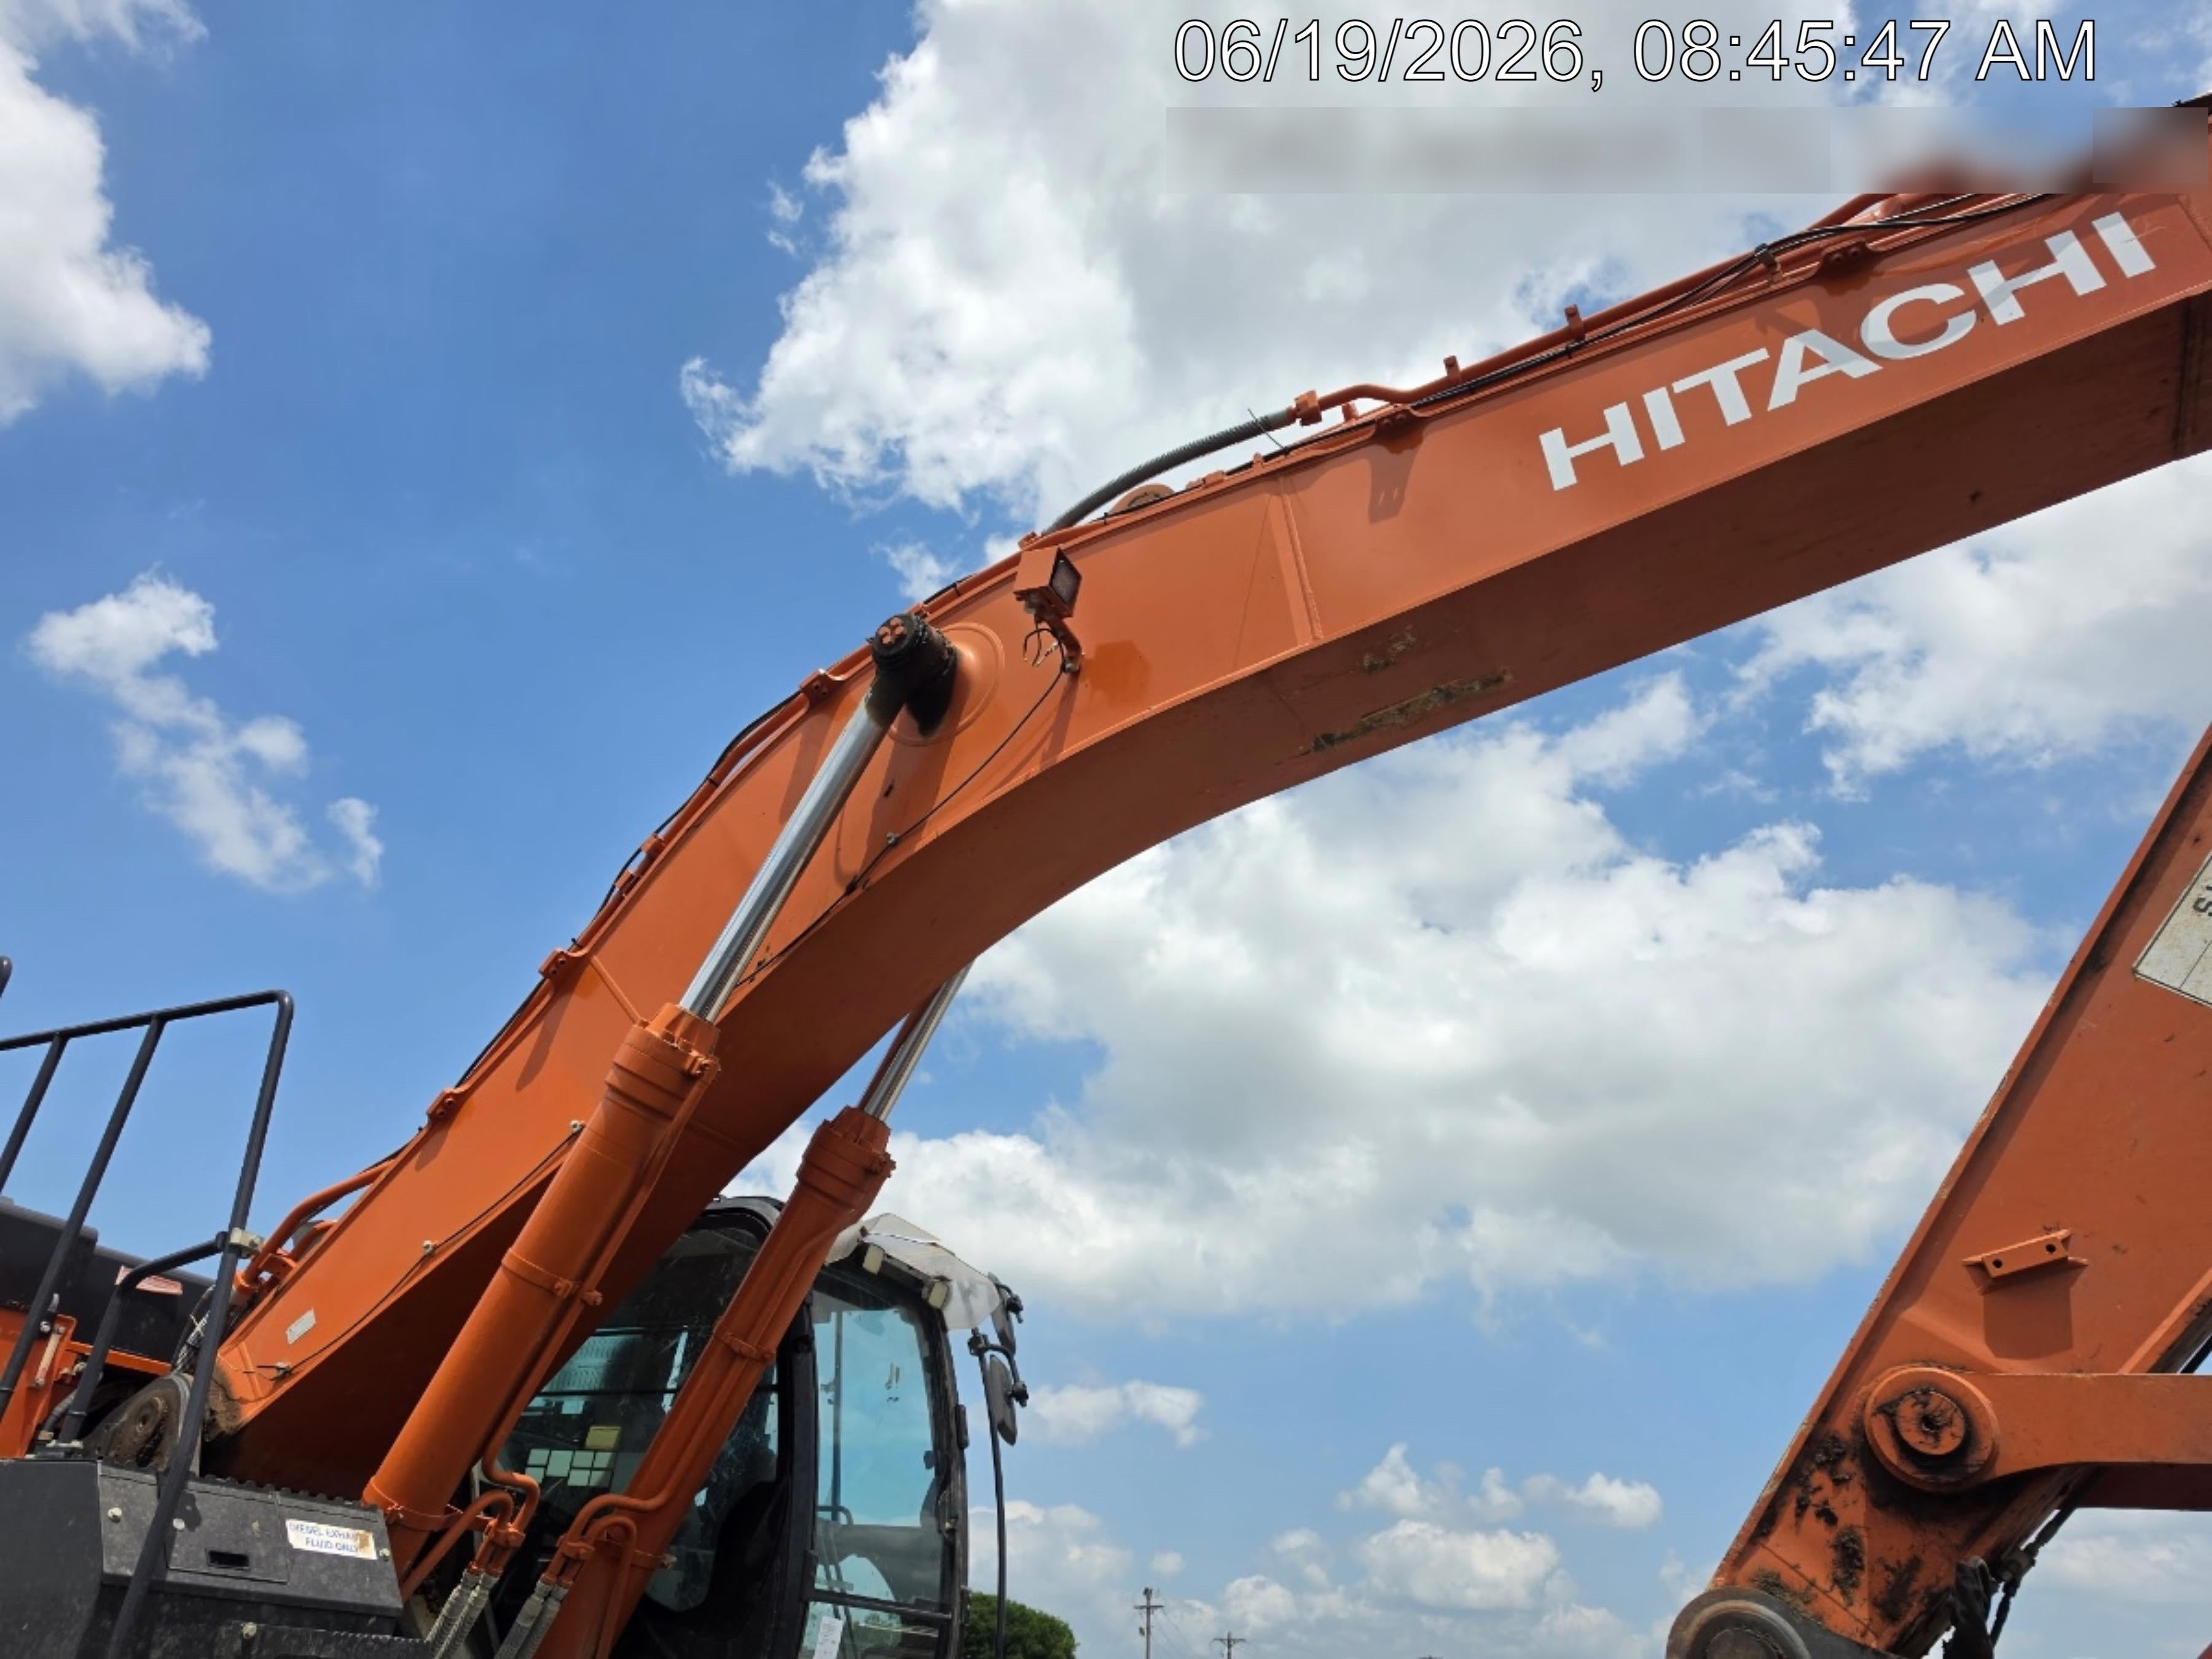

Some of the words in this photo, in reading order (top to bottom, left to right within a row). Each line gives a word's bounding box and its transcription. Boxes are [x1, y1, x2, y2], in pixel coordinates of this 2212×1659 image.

[1539, 211, 2155, 491] HITACHI
[305, 1537, 332, 1549] FLUID
[335, 1542, 359, 1553] ONLY
